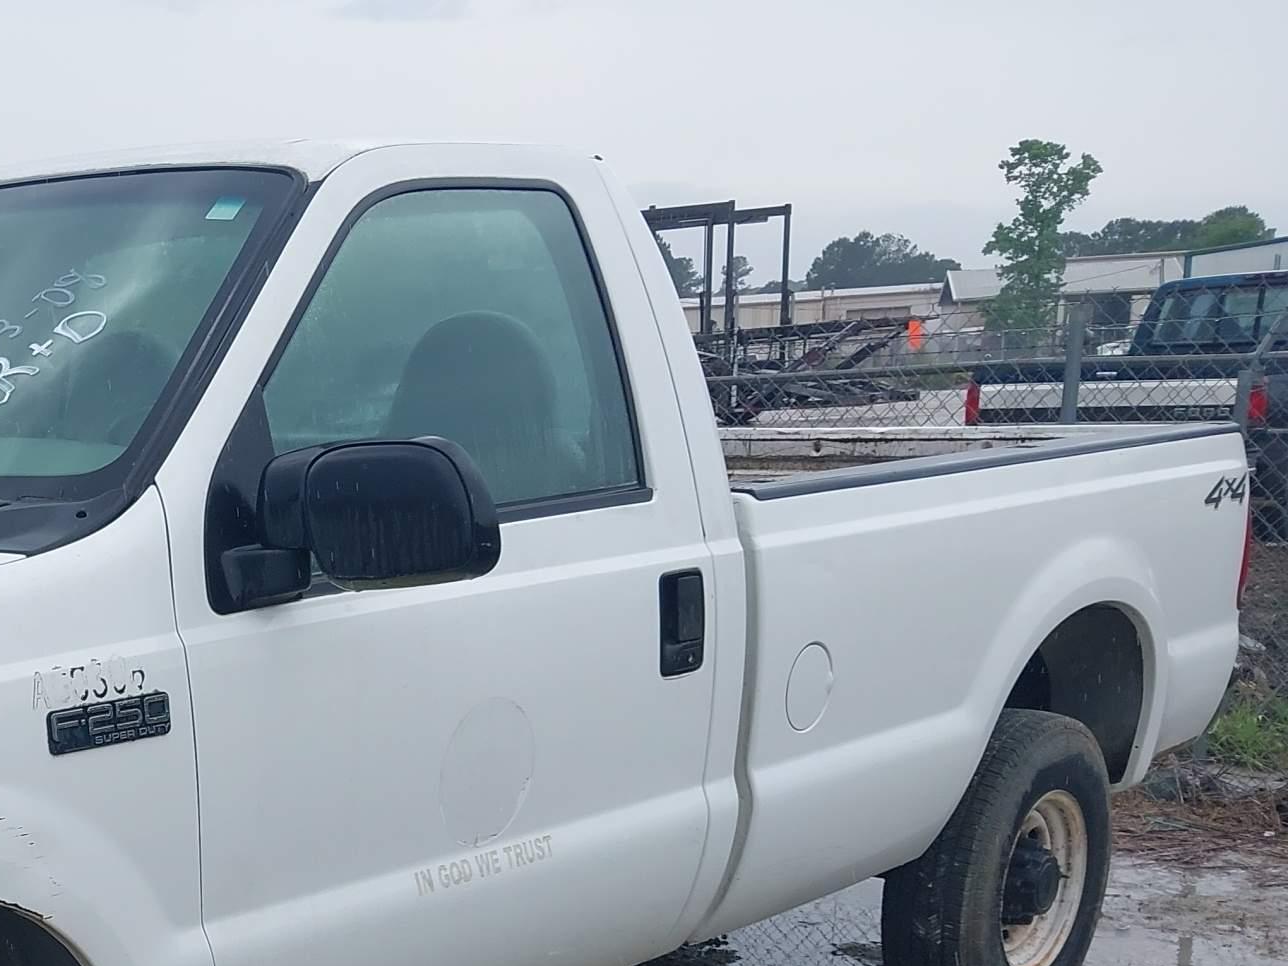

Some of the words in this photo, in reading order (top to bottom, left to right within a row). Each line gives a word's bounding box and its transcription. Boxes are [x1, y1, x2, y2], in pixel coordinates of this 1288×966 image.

[94, 729, 136, 745] SUPER
[139, 722, 171, 736] DUTY
[414, 868, 435, 896] IN
[438, 858, 473, 888] GOD
[474, 849, 502, 878] WE
[502, 834, 553, 868] TRUST
